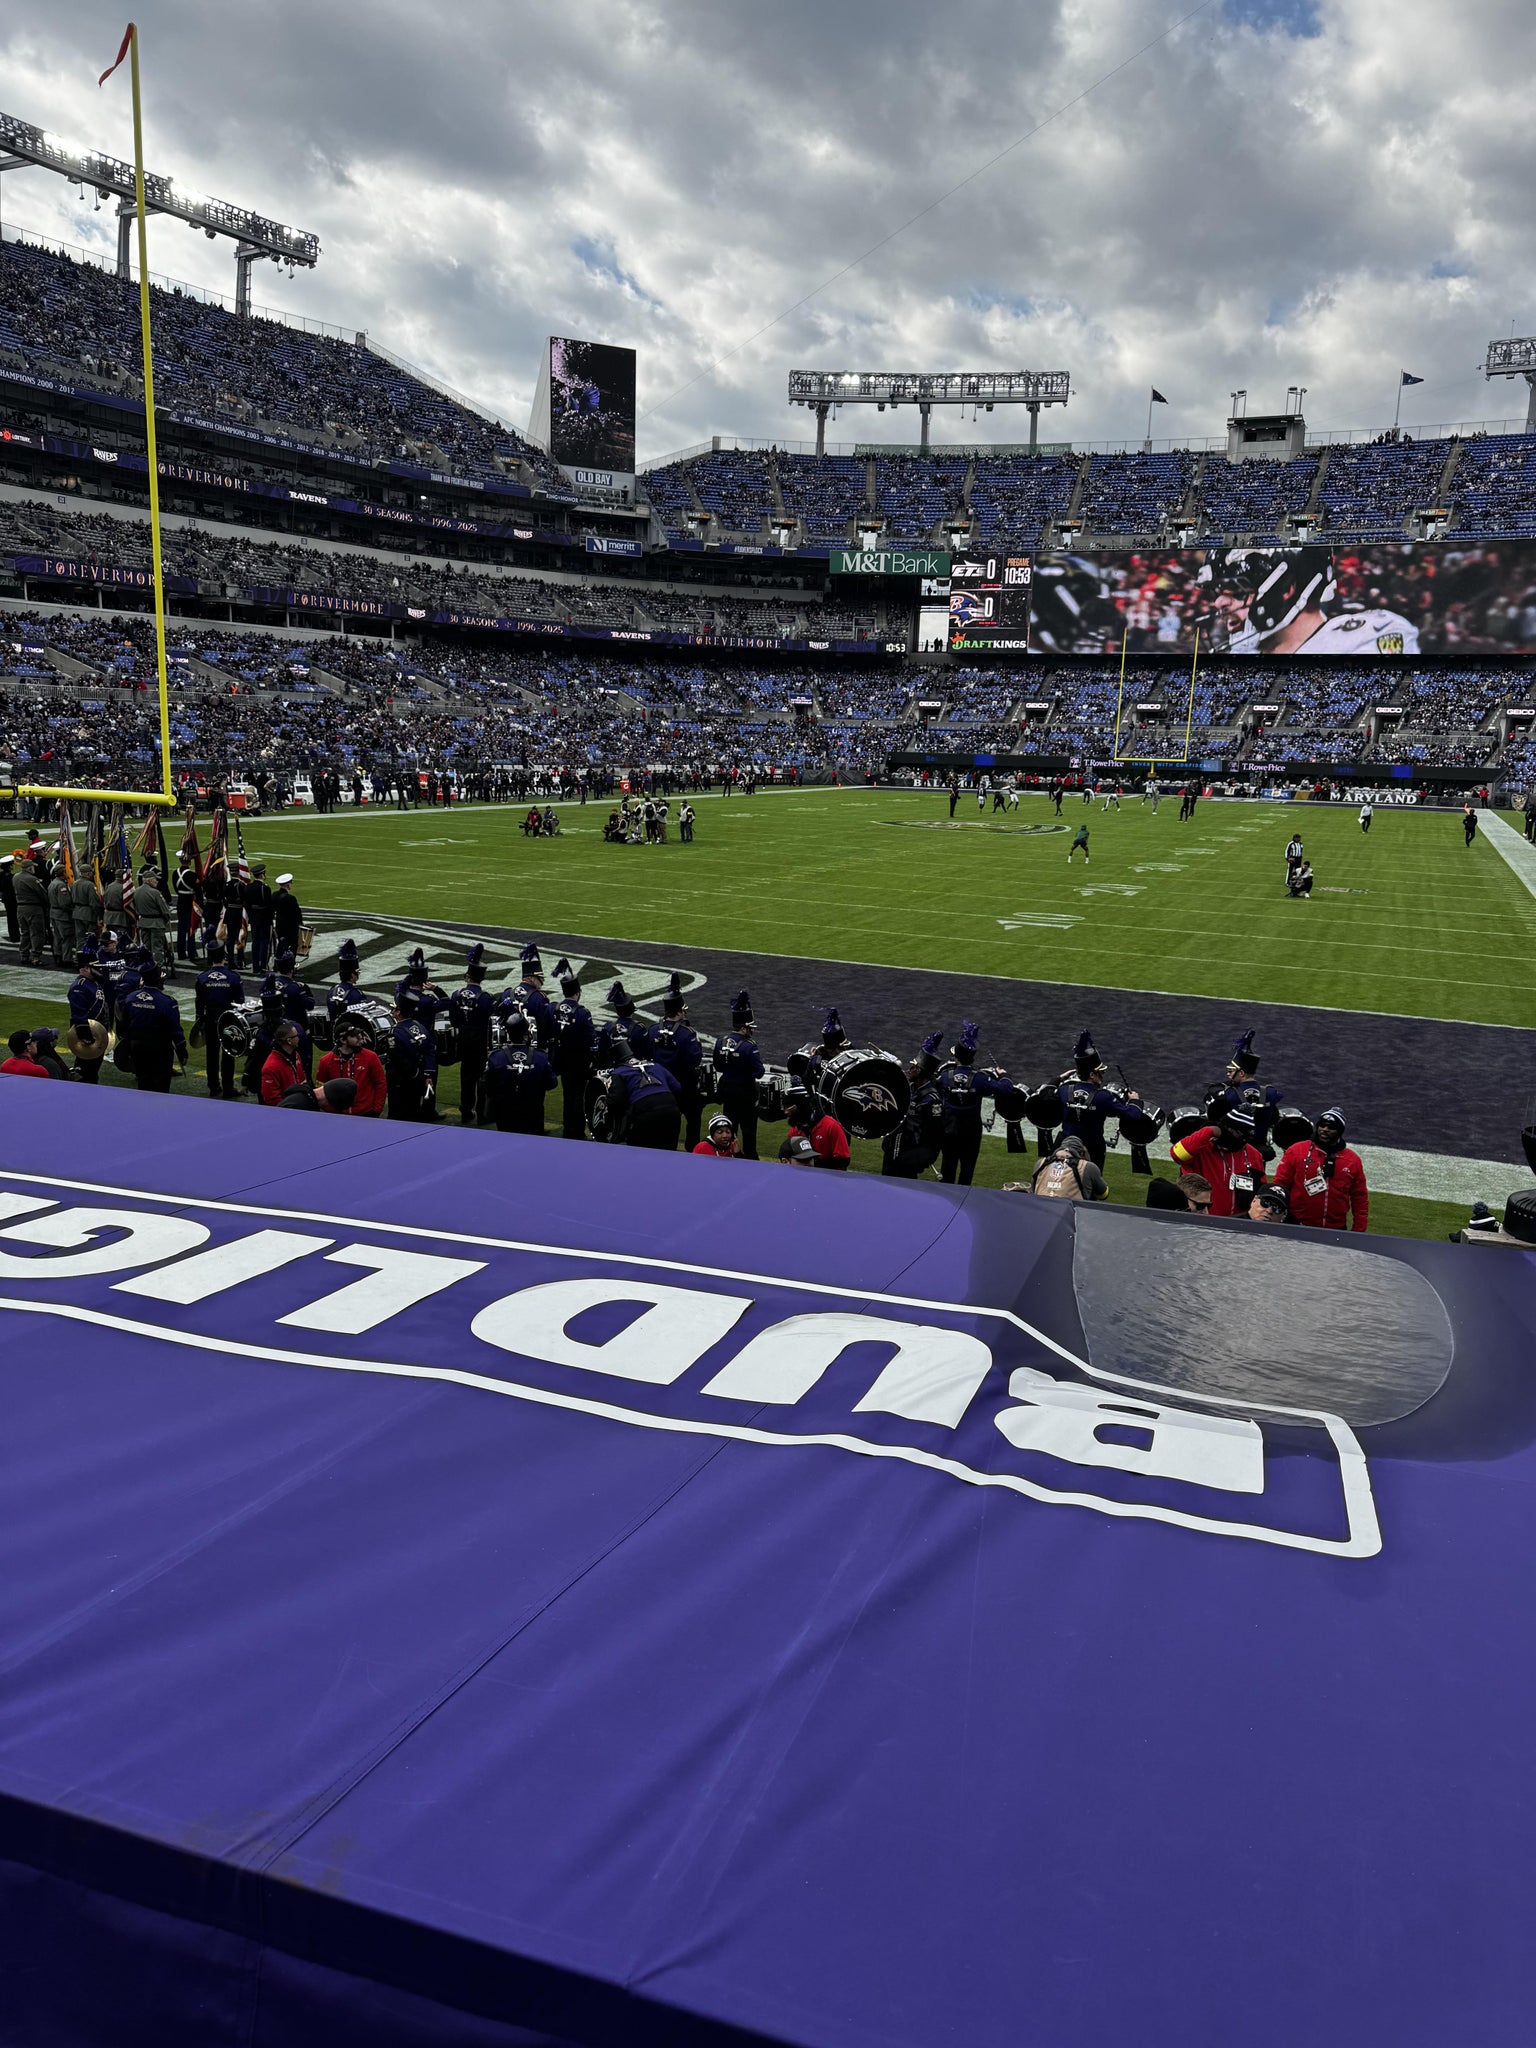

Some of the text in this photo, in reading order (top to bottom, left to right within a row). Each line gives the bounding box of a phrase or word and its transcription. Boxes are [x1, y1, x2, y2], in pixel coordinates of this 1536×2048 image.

[0, 369, 36, 385] HAMPIONS
[59, 384, 76, 395] 2012
[183, 416, 194, 424] AFC
[195, 419, 214, 430] NORTH
[214, 423, 246, 437] CHAMPIONS
[93, 448, 118, 462] RAVENS
[158, 462, 250, 492] OREVERMORE
[577, 471, 611, 485] OLD BAY
[289, 491, 327, 505] RAVENS
[363, 505, 373, 515] 30
[376, 508, 413, 522] SEASONS
[608, 542, 635, 551] merritt
[841, 552, 939, 573] M&T Bank
[986, 559, 996, 579] 0
[1007, 558, 1030, 566] PREGAME
[45, 559, 165, 587] FOREVERMOR
[1004, 567, 1031, 584] 10:53
[293, 593, 384, 615] FOREVERMORE
[984, 597, 993, 618] 0
[449, 614, 459, 623] 30
[462, 616, 499, 628] SEASONS
[611, 631, 651, 640] RAVENS
[688, 635, 781, 649] FOREVERMORE
[952, 640, 1026, 650] DRAFTKINGS
[1330, 792, 1417, 804] MARYLAND
[996, 911, 1086, 931] 10
[0, 1192, 1263, 1494] BUD LIG
